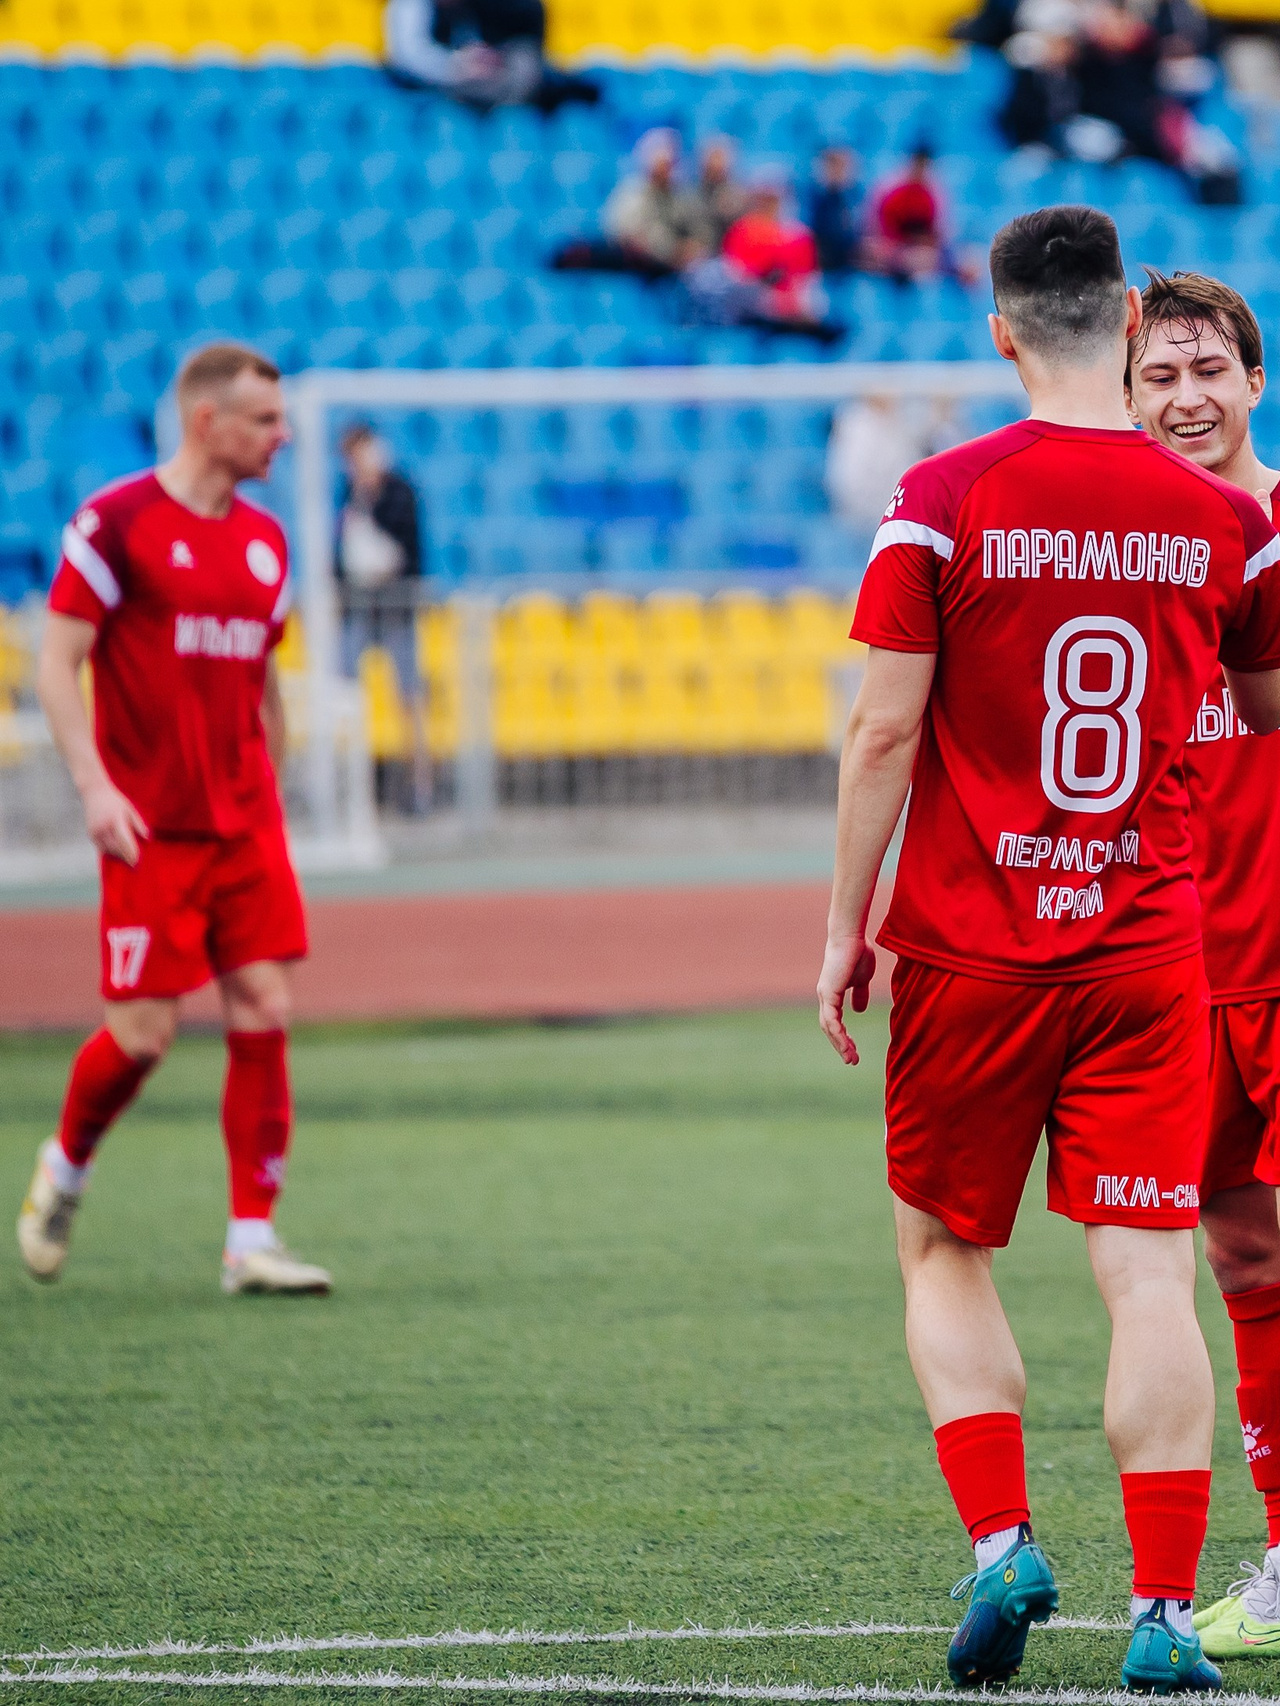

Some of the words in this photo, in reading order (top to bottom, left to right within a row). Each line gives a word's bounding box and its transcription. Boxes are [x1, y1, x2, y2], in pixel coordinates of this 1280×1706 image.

[982, 529, 1211, 588] ПАРАМОНОВ
[1040, 615, 1148, 813] 8
[1036, 880, 1104, 920] КРАЙ
[106, 925, 151, 990] 17
